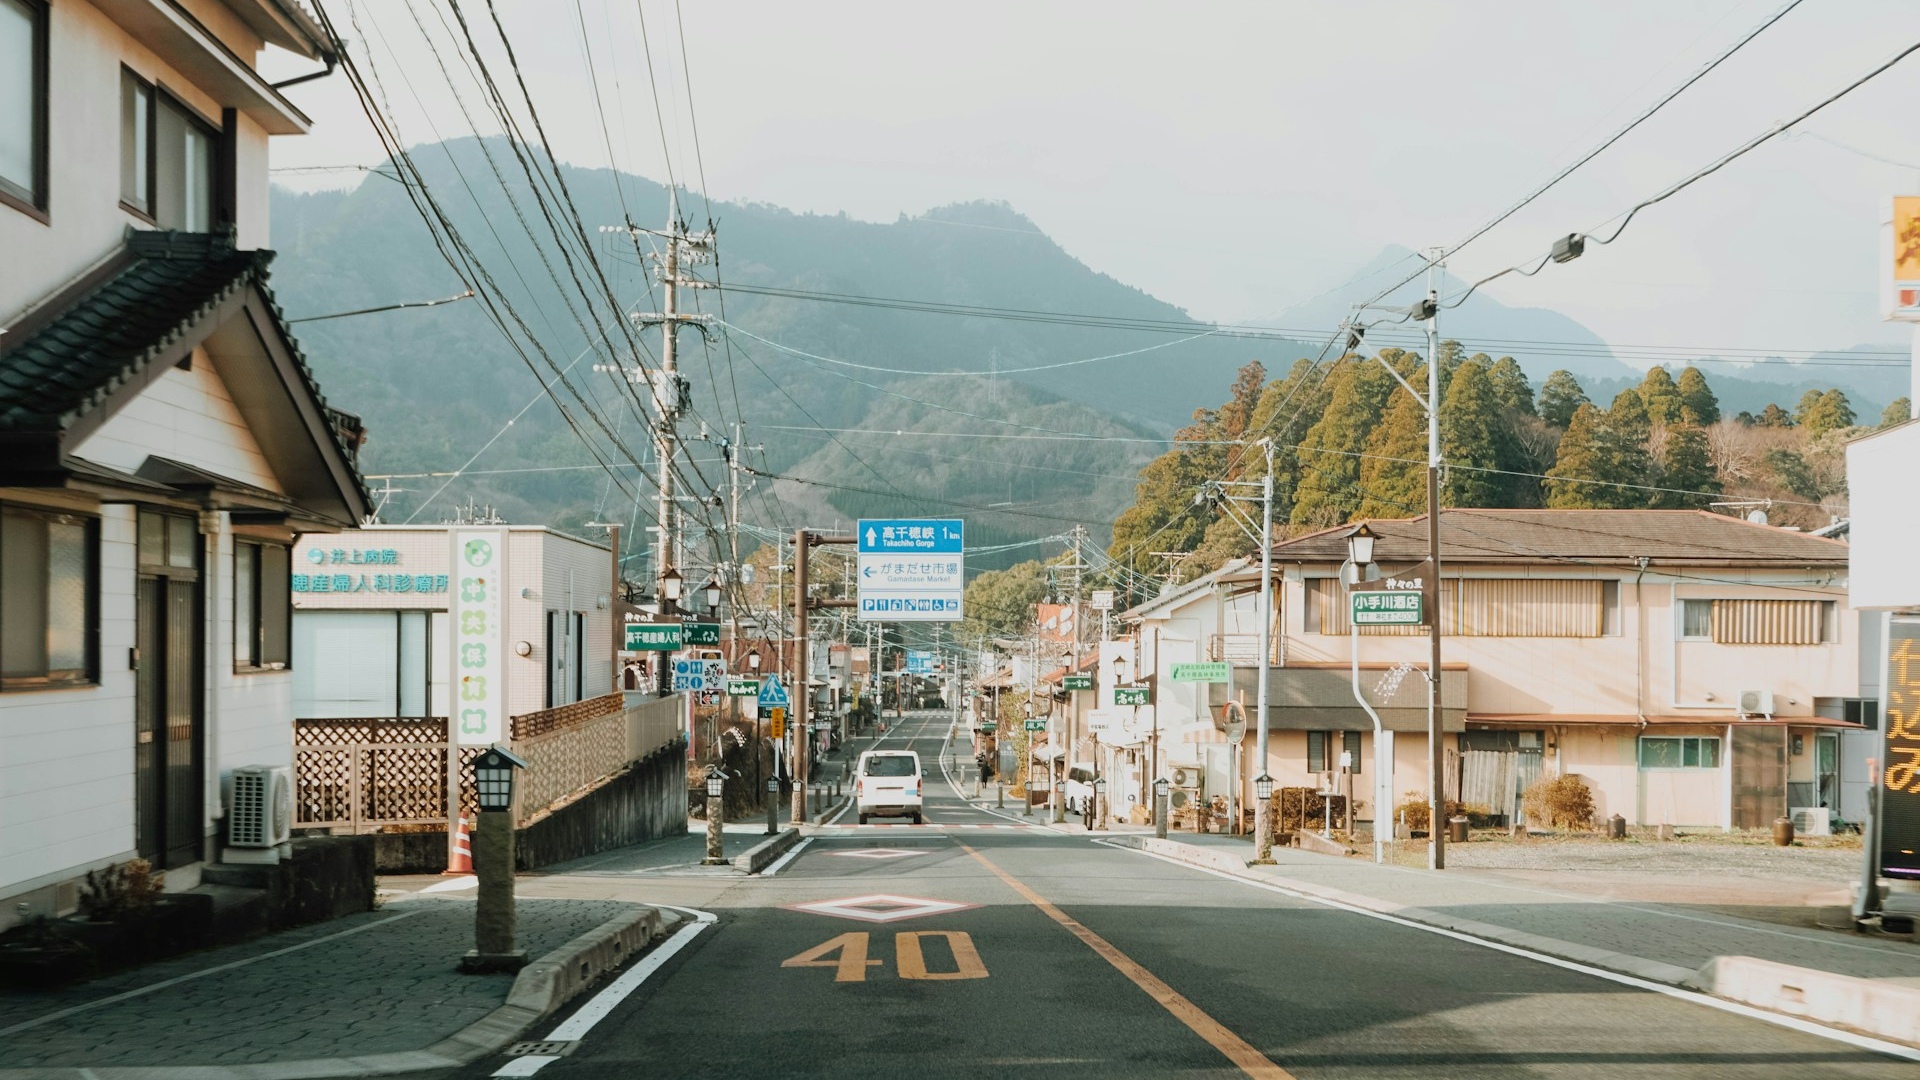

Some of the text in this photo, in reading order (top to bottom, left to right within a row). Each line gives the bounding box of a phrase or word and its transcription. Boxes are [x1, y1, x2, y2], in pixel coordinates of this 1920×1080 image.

[882, 526, 935, 540] 高千穂峡
[915, 540, 936, 549] Gorge
[330, 547, 398, 565] 井上病院
[880, 562, 958, 575] がまだせ市場
[887, 575, 951, 583] Gamadase Market
[1354, 595, 1420, 610] 小手川酒店
[626, 631, 681, 644] 高千穂産婦人科
[780, 930, 990, 982] 40
